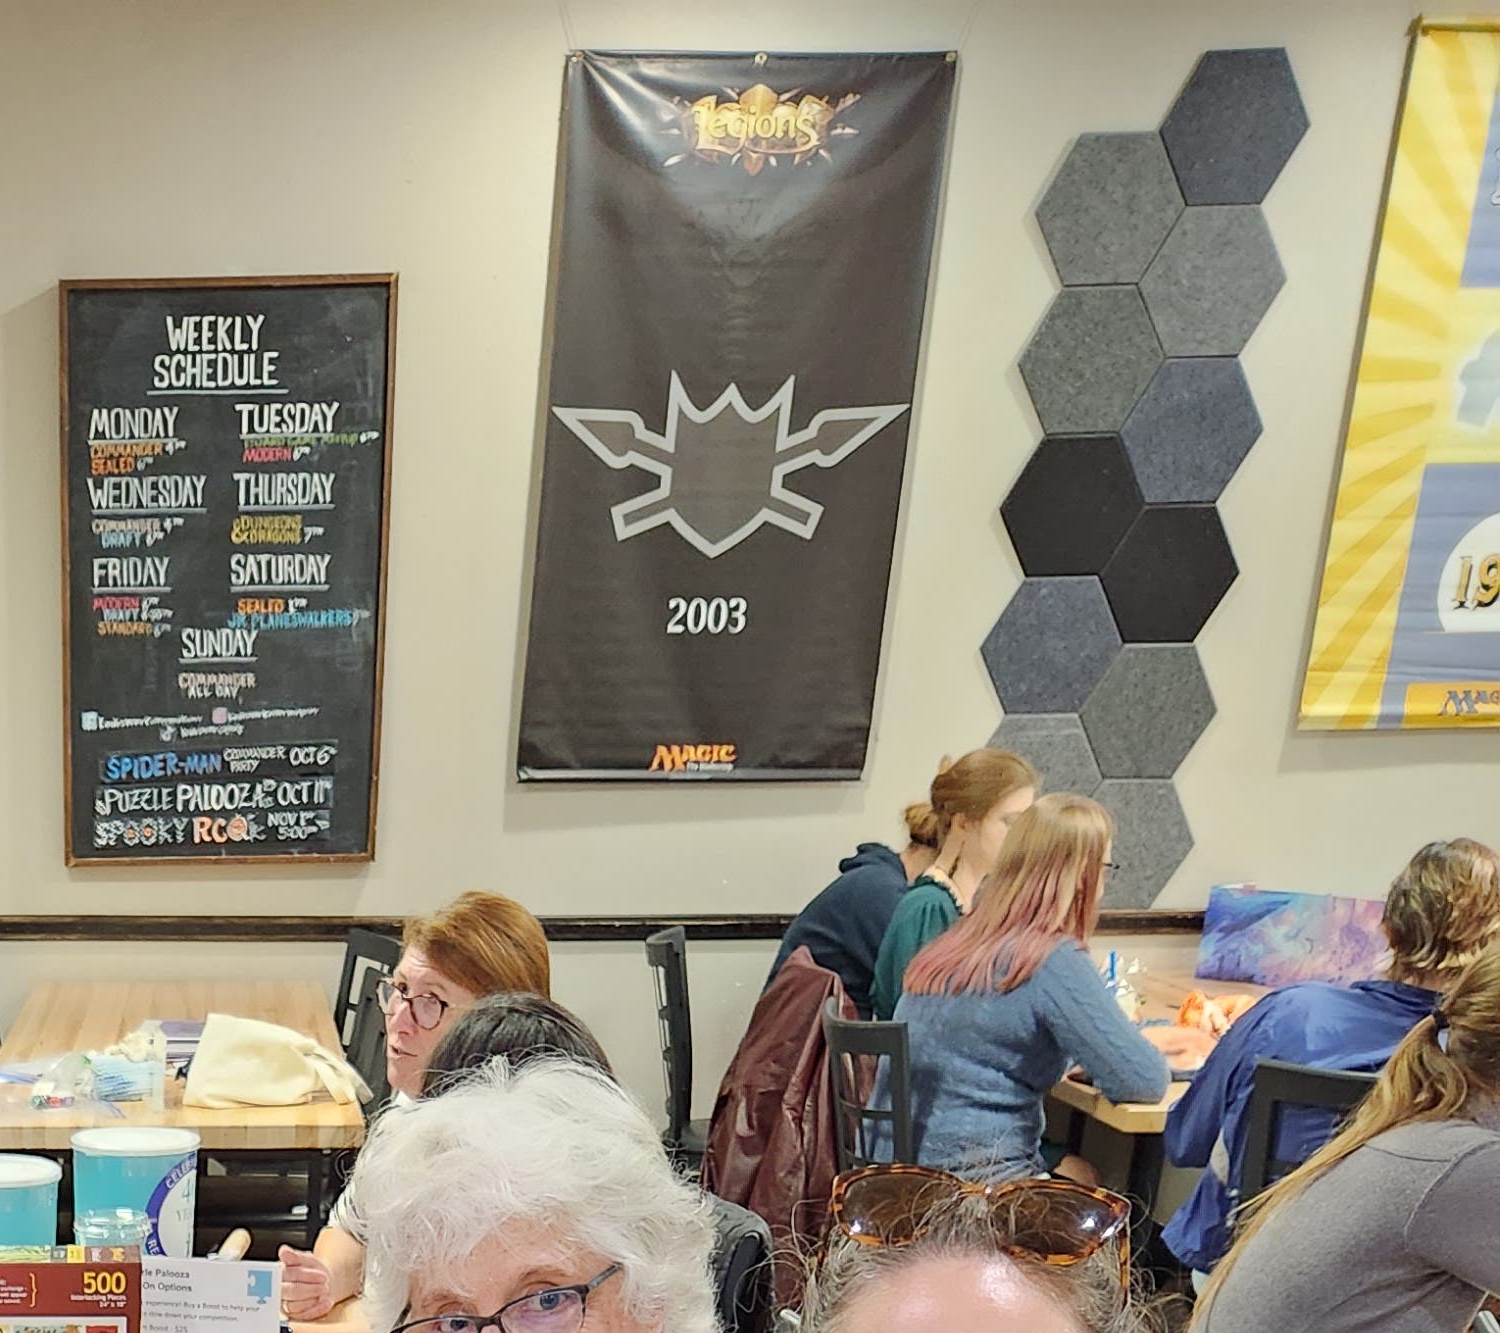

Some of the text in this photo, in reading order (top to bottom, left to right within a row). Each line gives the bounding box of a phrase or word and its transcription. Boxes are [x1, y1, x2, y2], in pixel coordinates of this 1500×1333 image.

[693, 96, 821, 155] Legions
[166, 315, 265, 352] WEEKLY
[153, 352, 279, 388] SCHEDULE
[89, 406, 179, 440] MONDAY
[234, 401, 340, 434] TUESDAY
[91, 456, 135, 475] SEALED
[243, 447, 291, 463] MODERN
[87, 475, 207, 509] WEDNESDAY
[233, 472, 336, 506] THURSDAY
[92, 556, 171, 588] FRIDAY
[230, 553, 332, 585] SATURDAY
[237, 597, 285, 615] SEALED
[666, 597, 748, 634] 2003
[181, 627, 259, 659] SUNDAY
[106, 746, 288, 780] SPIDER-MAN COMMANDER
[230, 759, 260, 773] PARTY
[289, 746, 318, 766] OCT
[649, 744, 738, 772] MAGIC
[103, 787, 175, 816] PUZZLE
[176, 783, 263, 813] PALOOZA
[277, 781, 313, 806] OCT
[94, 816, 189, 848] SPOOKY
[267, 811, 298, 827] NOV
[83, 1271, 127, 1295] 500
[155, 1268, 190, 1279] Palooza
[158, 1282, 193, 1293] Options
